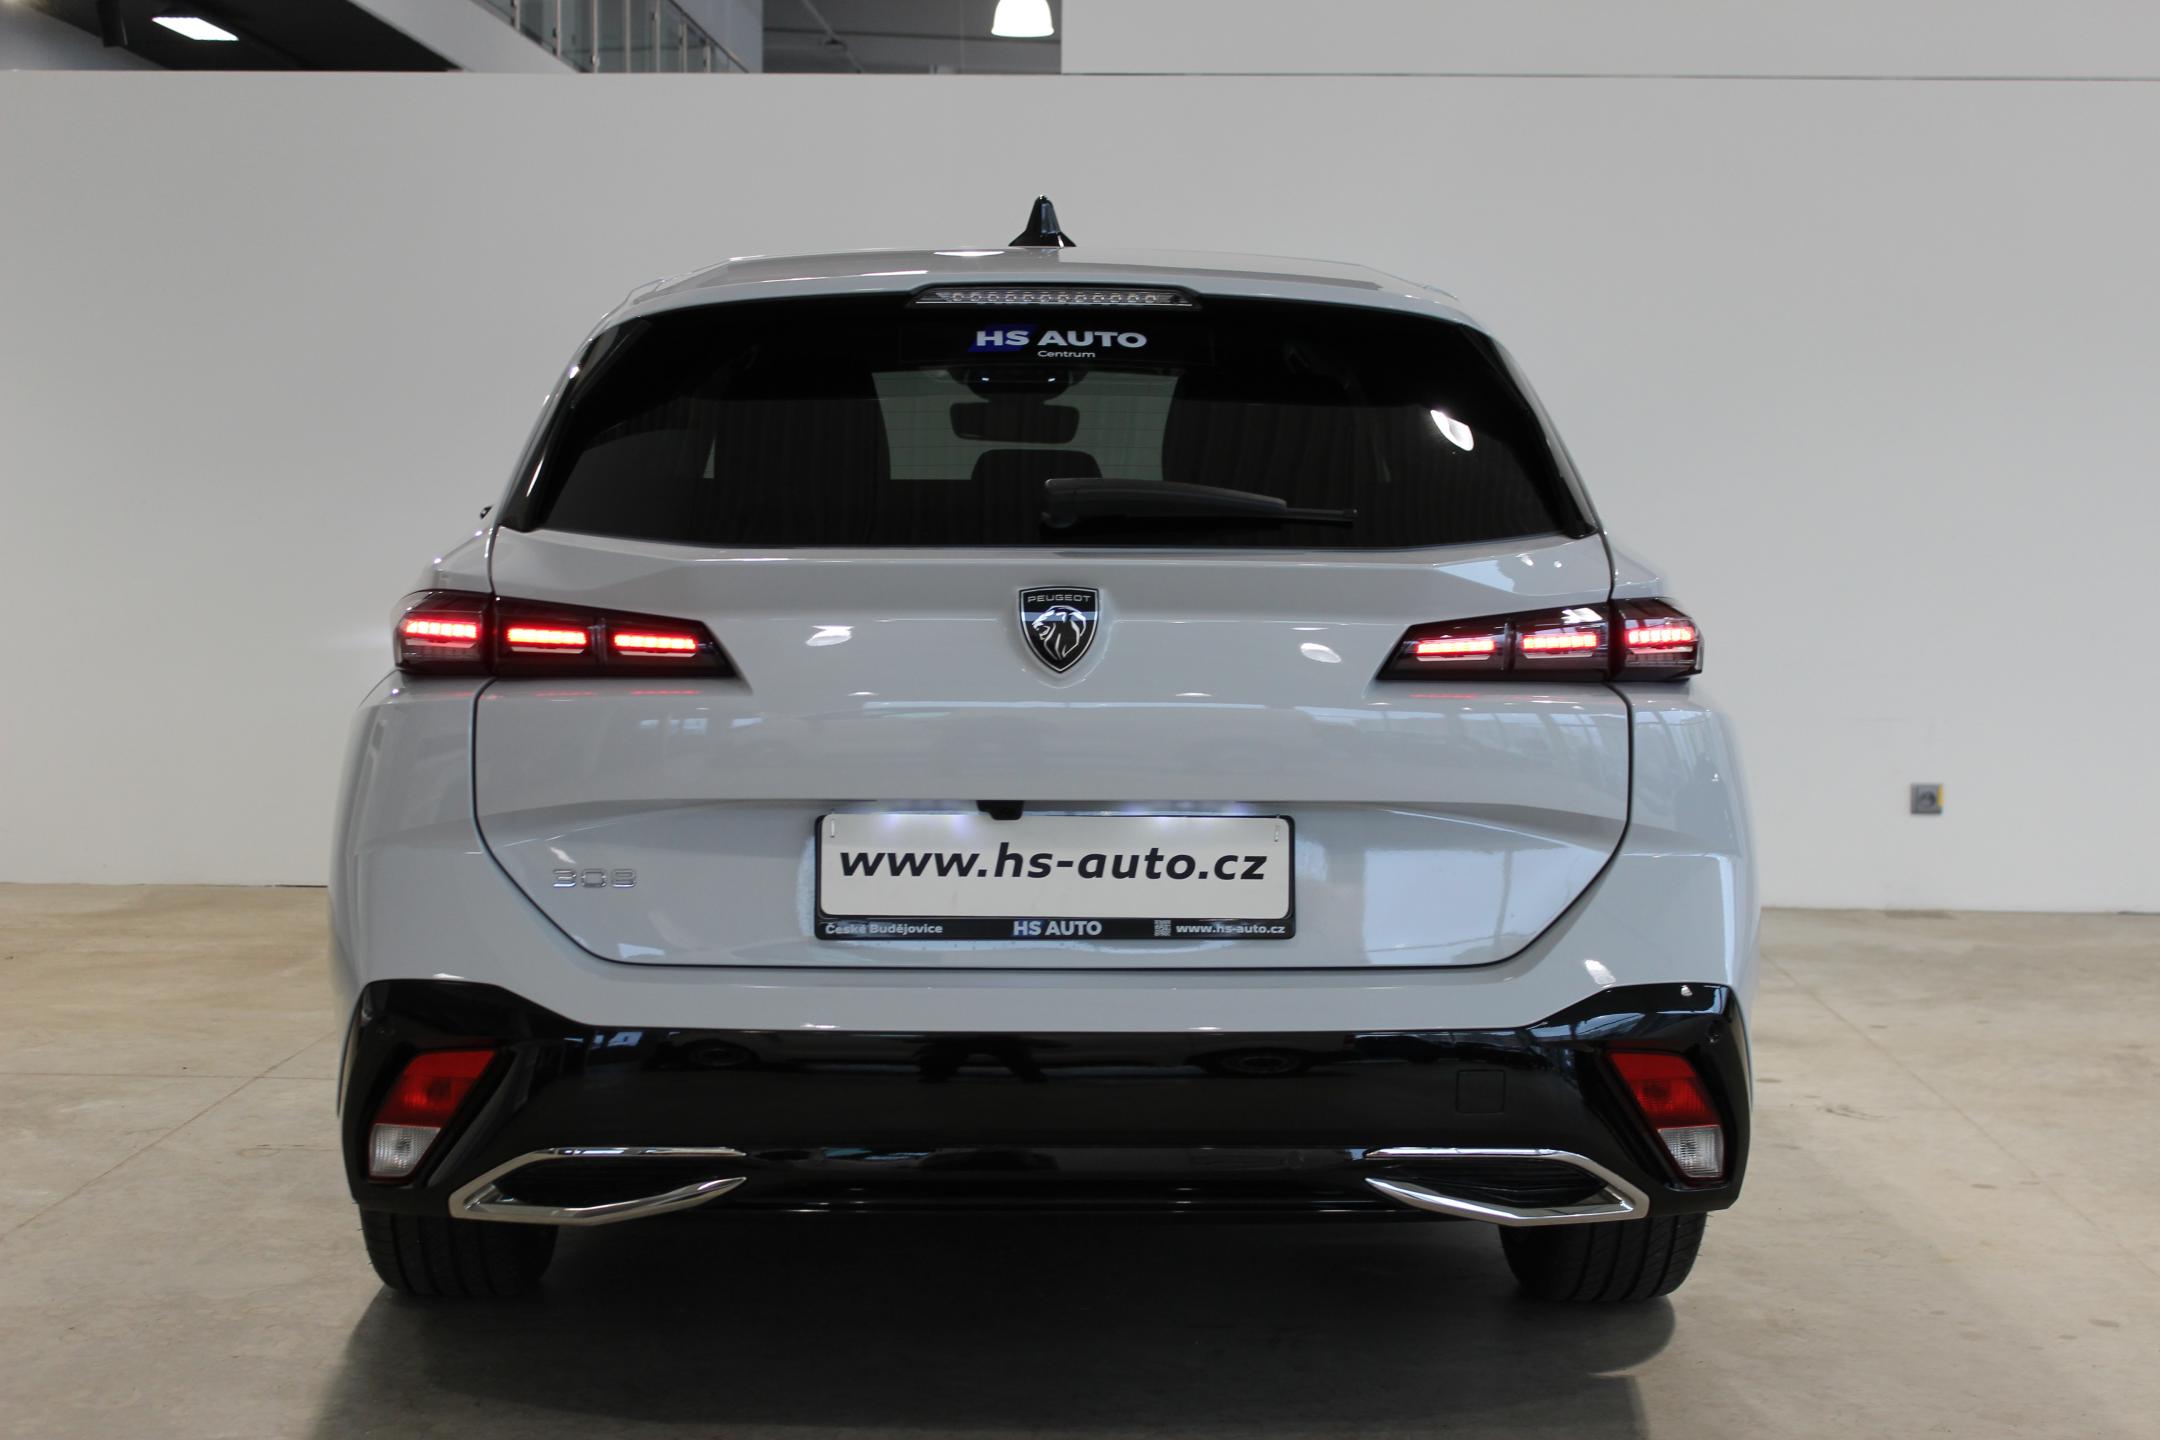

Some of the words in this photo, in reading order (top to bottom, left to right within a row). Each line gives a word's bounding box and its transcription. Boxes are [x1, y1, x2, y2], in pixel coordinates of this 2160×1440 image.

[976, 330, 1030, 346] HS
[1037, 330, 1147, 348] AUTO
[1037, 350, 1096, 358] Centrum
[1027, 594, 1092, 603] PEUGEOT
[840, 841, 1267, 880] www.hs-auto.cz
[552, 868, 637, 889] 308
[825, 922, 867, 934] České
[869, 923, 943, 935] Budějovice
[1013, 920, 1042, 936] HS
[1045, 920, 1103, 936] AUTO
[1176, 922, 1286, 934] www.hs-auto.cz
